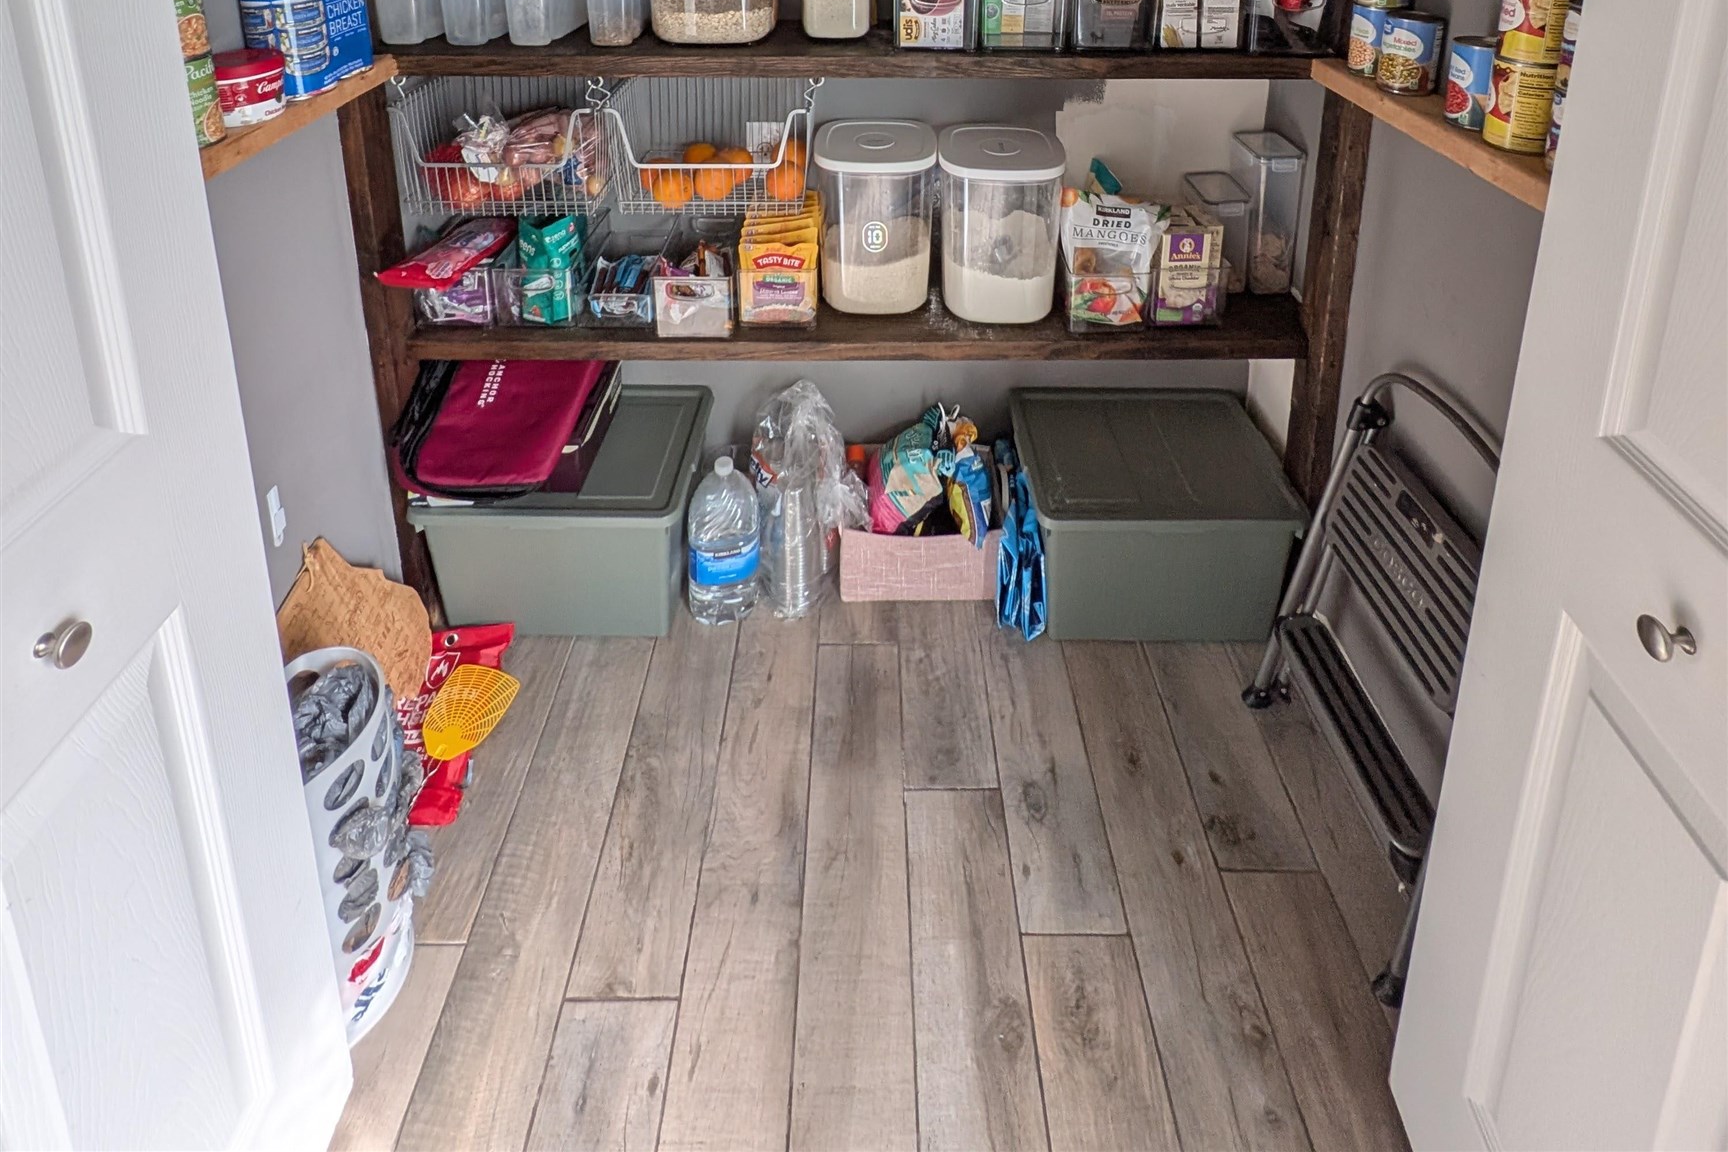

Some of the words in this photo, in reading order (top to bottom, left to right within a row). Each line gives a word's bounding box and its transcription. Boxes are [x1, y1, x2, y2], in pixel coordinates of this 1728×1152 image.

[329, 11, 362, 36] BREAST
[1393, 36, 1417, 46] Mixed
[1520, 71, 1554, 80] Nutrition
[1518, 90, 1545, 98] Calories
[1098, 206, 1130, 215] KIRKLAND
[1093, 218, 1132, 228] DRIED
[1072, 227, 1147, 245] MANGOES
[757, 256, 782, 266] TASTY
[783, 257, 801, 267] BITE
[477, 364, 499, 406] HOCKING
[486, 364, 506, 402] ANCHOR
